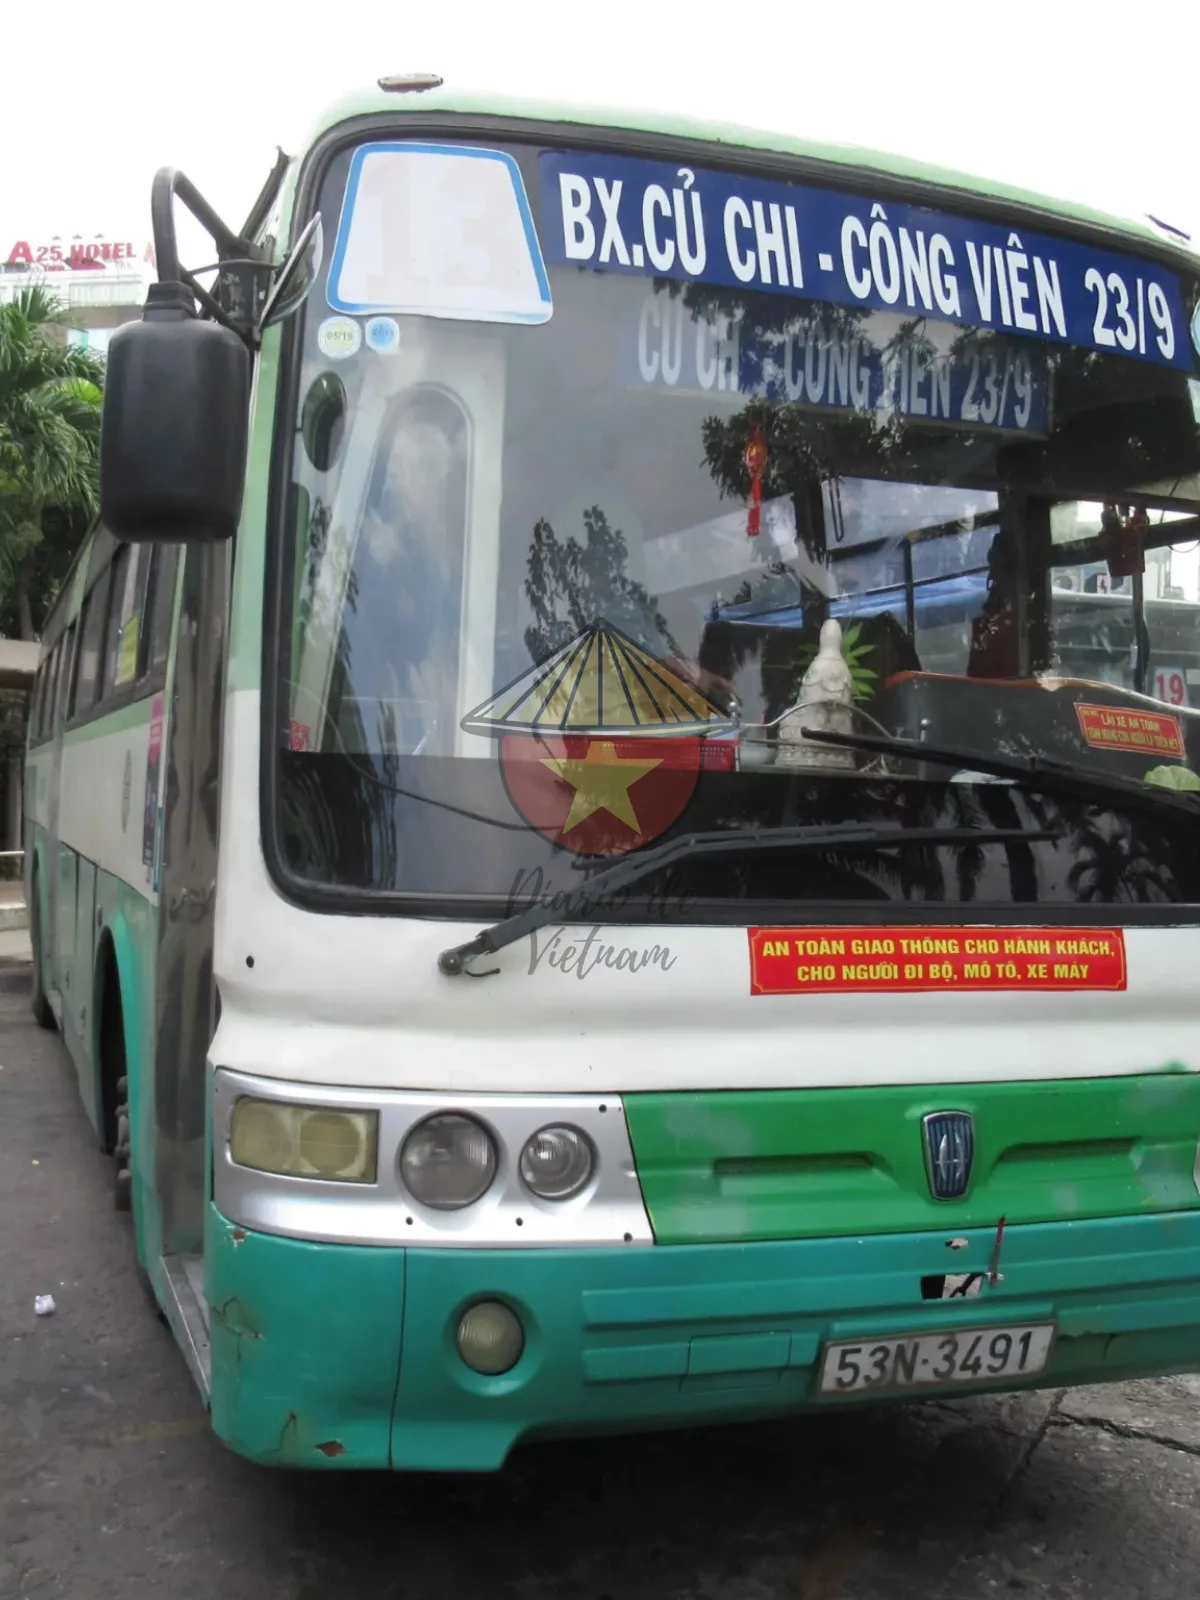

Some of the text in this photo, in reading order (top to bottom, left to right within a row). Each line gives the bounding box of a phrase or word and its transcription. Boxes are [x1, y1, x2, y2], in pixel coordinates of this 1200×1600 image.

[70, 242, 136, 261] HOTEL
[559, 168, 706, 276] BX.CỦ
[723, 196, 804, 289] CHI
[841, 203, 962, 318] CÔNG
[965, 232, 1067, 338] VIÊN
[1084, 268, 1175, 360] 23/9
[961, 348, 1032, 428] 23/9
[1156, 673, 1185, 706] 19
[762, 936, 1115, 957] AN TOÀN GIAO THÔNG CHO HÀNH KHÁCH,
[797, 960, 1089, 982] CHO NGƯỜI ĐI BỘ, MÔ TÔ, XE MÁY
